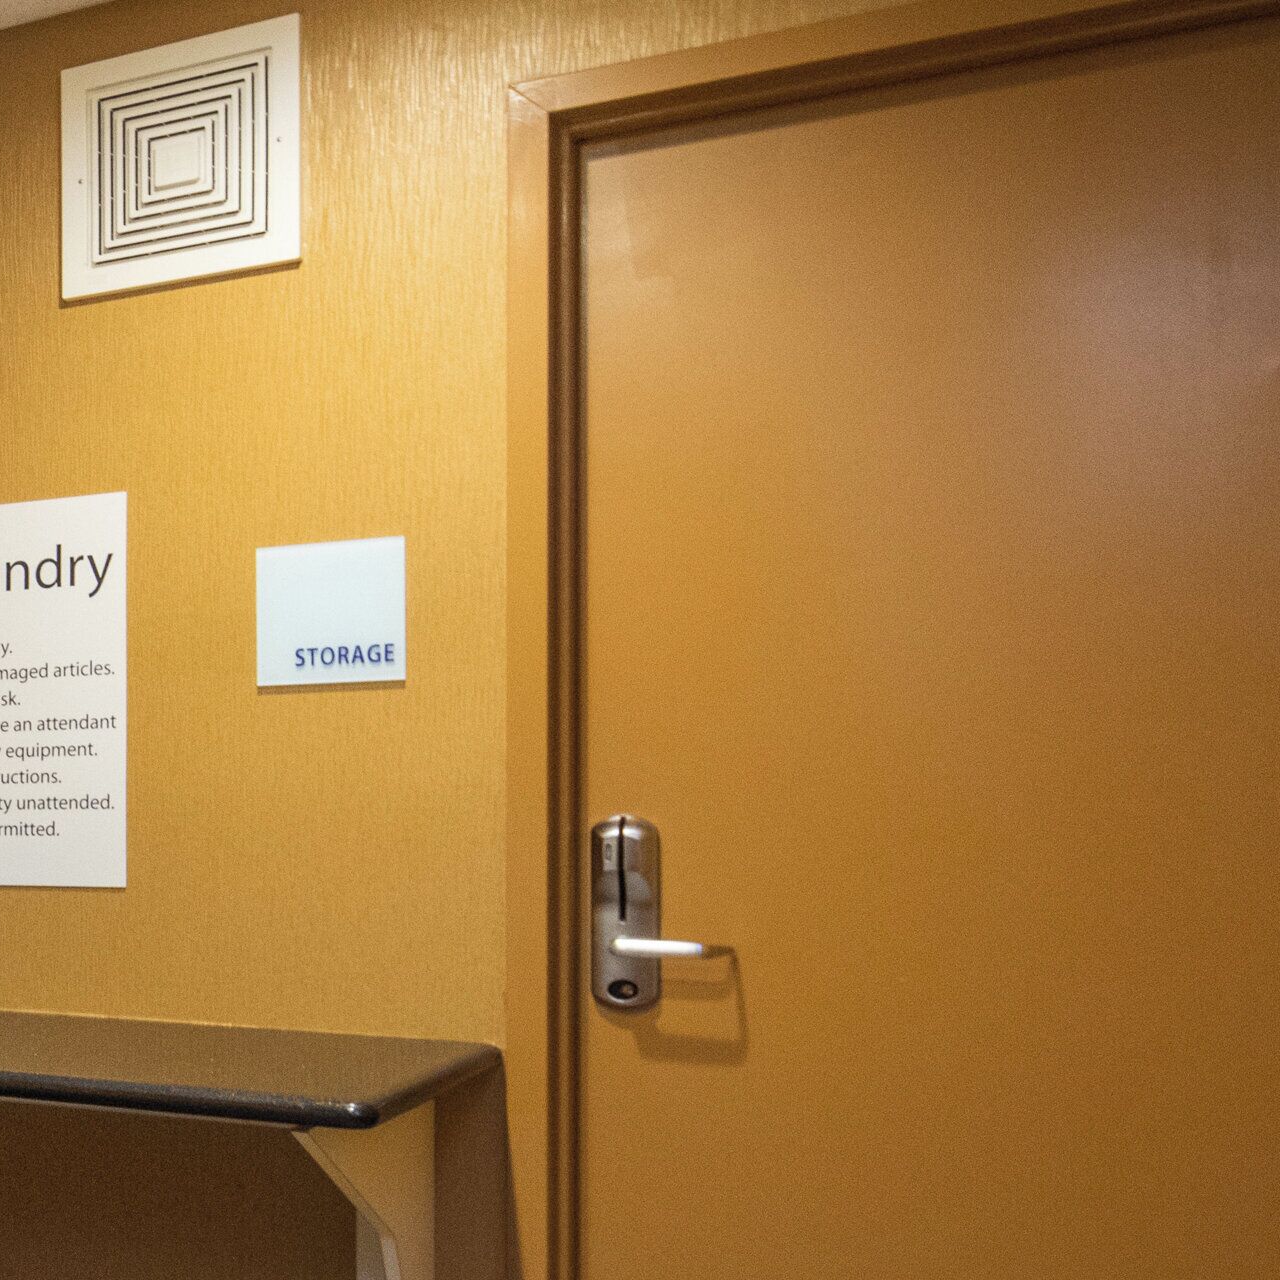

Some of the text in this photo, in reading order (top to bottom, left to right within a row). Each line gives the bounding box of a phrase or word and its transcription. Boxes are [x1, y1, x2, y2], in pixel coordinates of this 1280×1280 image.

[295, 643, 395, 668] STORAGE
[53, 660, 114, 677] articles.
[13, 720, 31, 731] an
[36, 713, 115, 731] attendant
[5, 742, 97, 761] equipment.
[16, 793, 114, 810] unattended.
